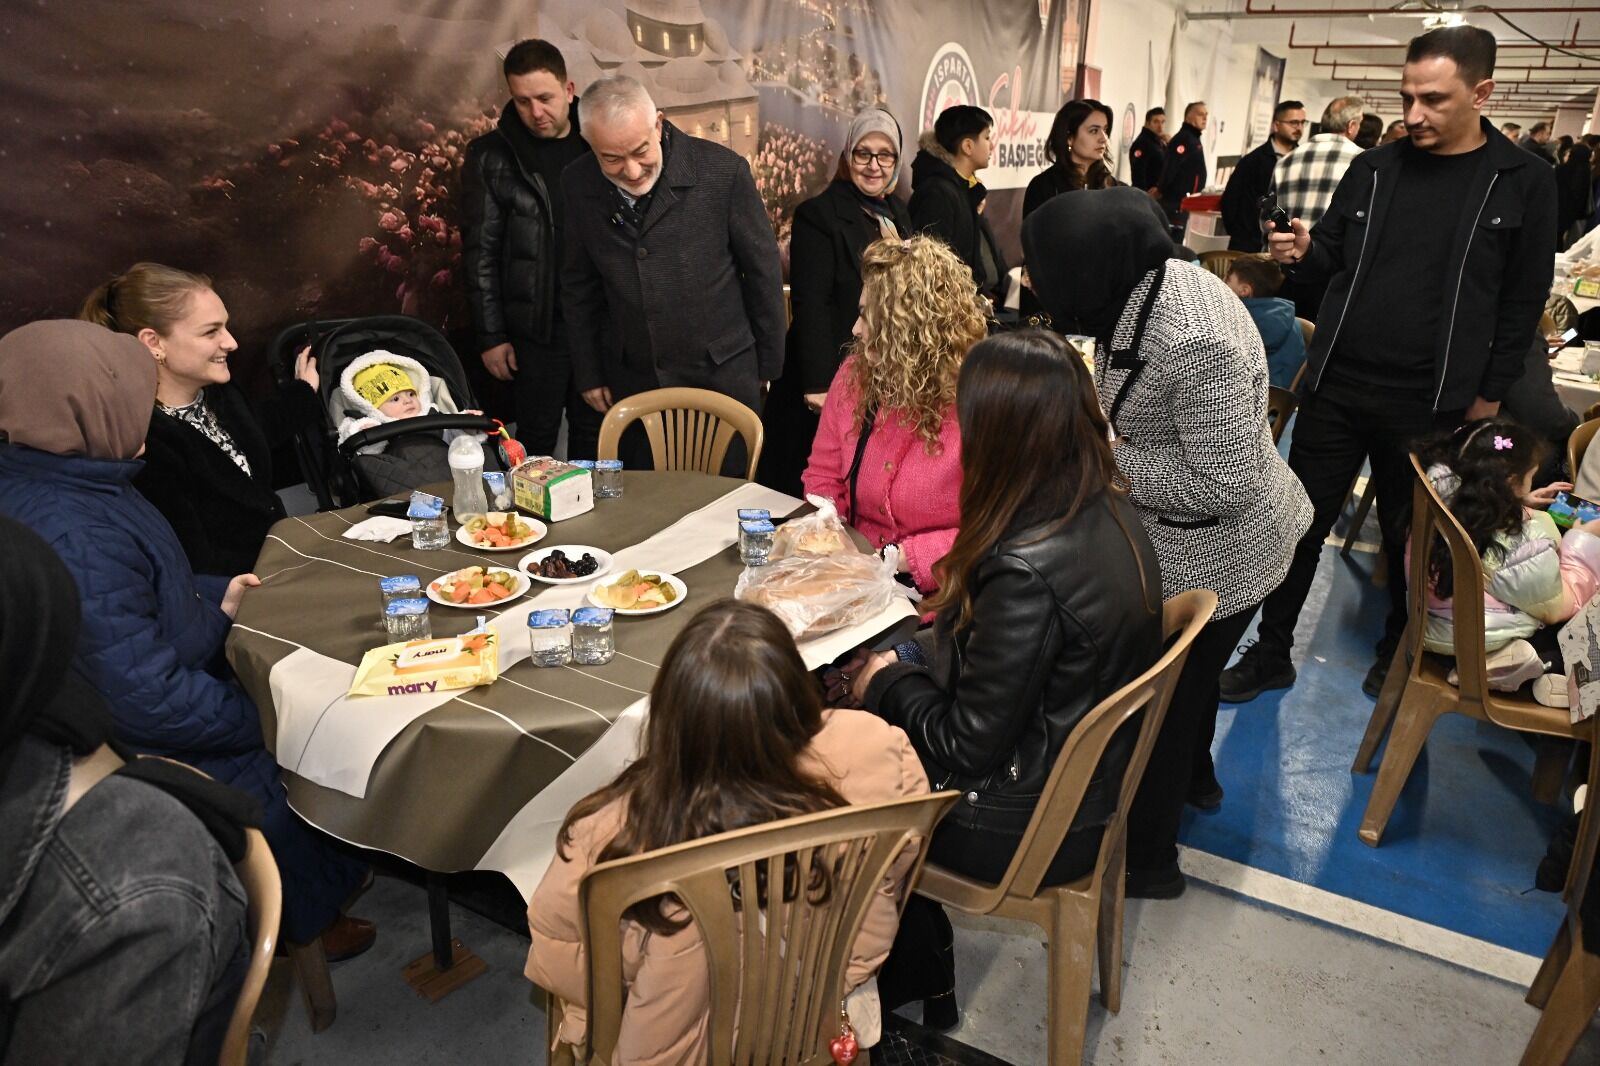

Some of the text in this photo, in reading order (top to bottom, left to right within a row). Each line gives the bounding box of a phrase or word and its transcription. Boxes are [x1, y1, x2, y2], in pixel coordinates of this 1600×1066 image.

[934, 57, 971, 92] ISPARTA
[999, 138, 1051, 173] BAŞDEĞ
[412, 648, 447, 659] mary
[387, 680, 437, 696] mary
